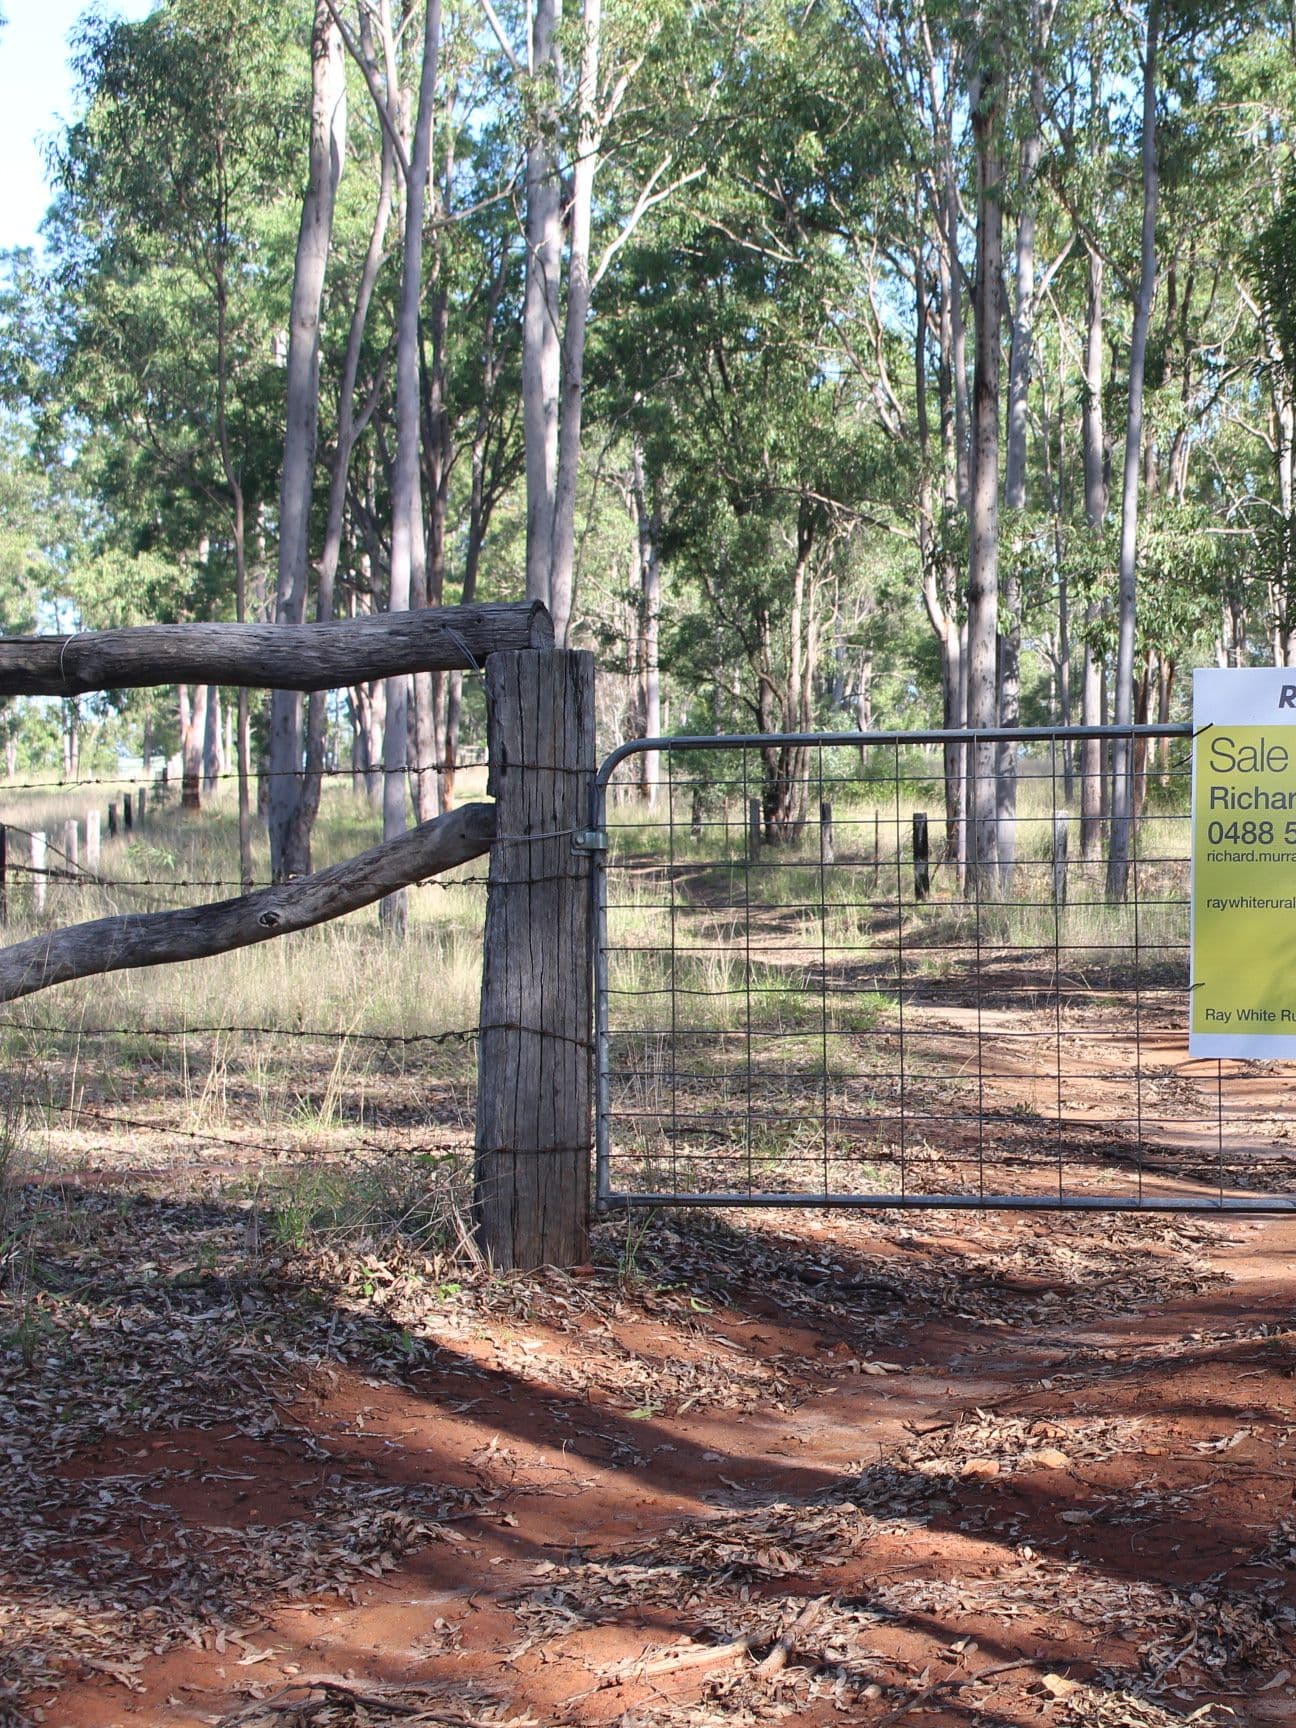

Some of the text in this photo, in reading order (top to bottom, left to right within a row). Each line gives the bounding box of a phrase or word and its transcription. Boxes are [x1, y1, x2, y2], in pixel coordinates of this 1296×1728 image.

[1209, 737, 1289, 773] Sale
[1208, 820, 1274, 845] 0488
[1205, 1008, 1232, 1024] Ray
[1236, 1009, 1276, 1023] White
